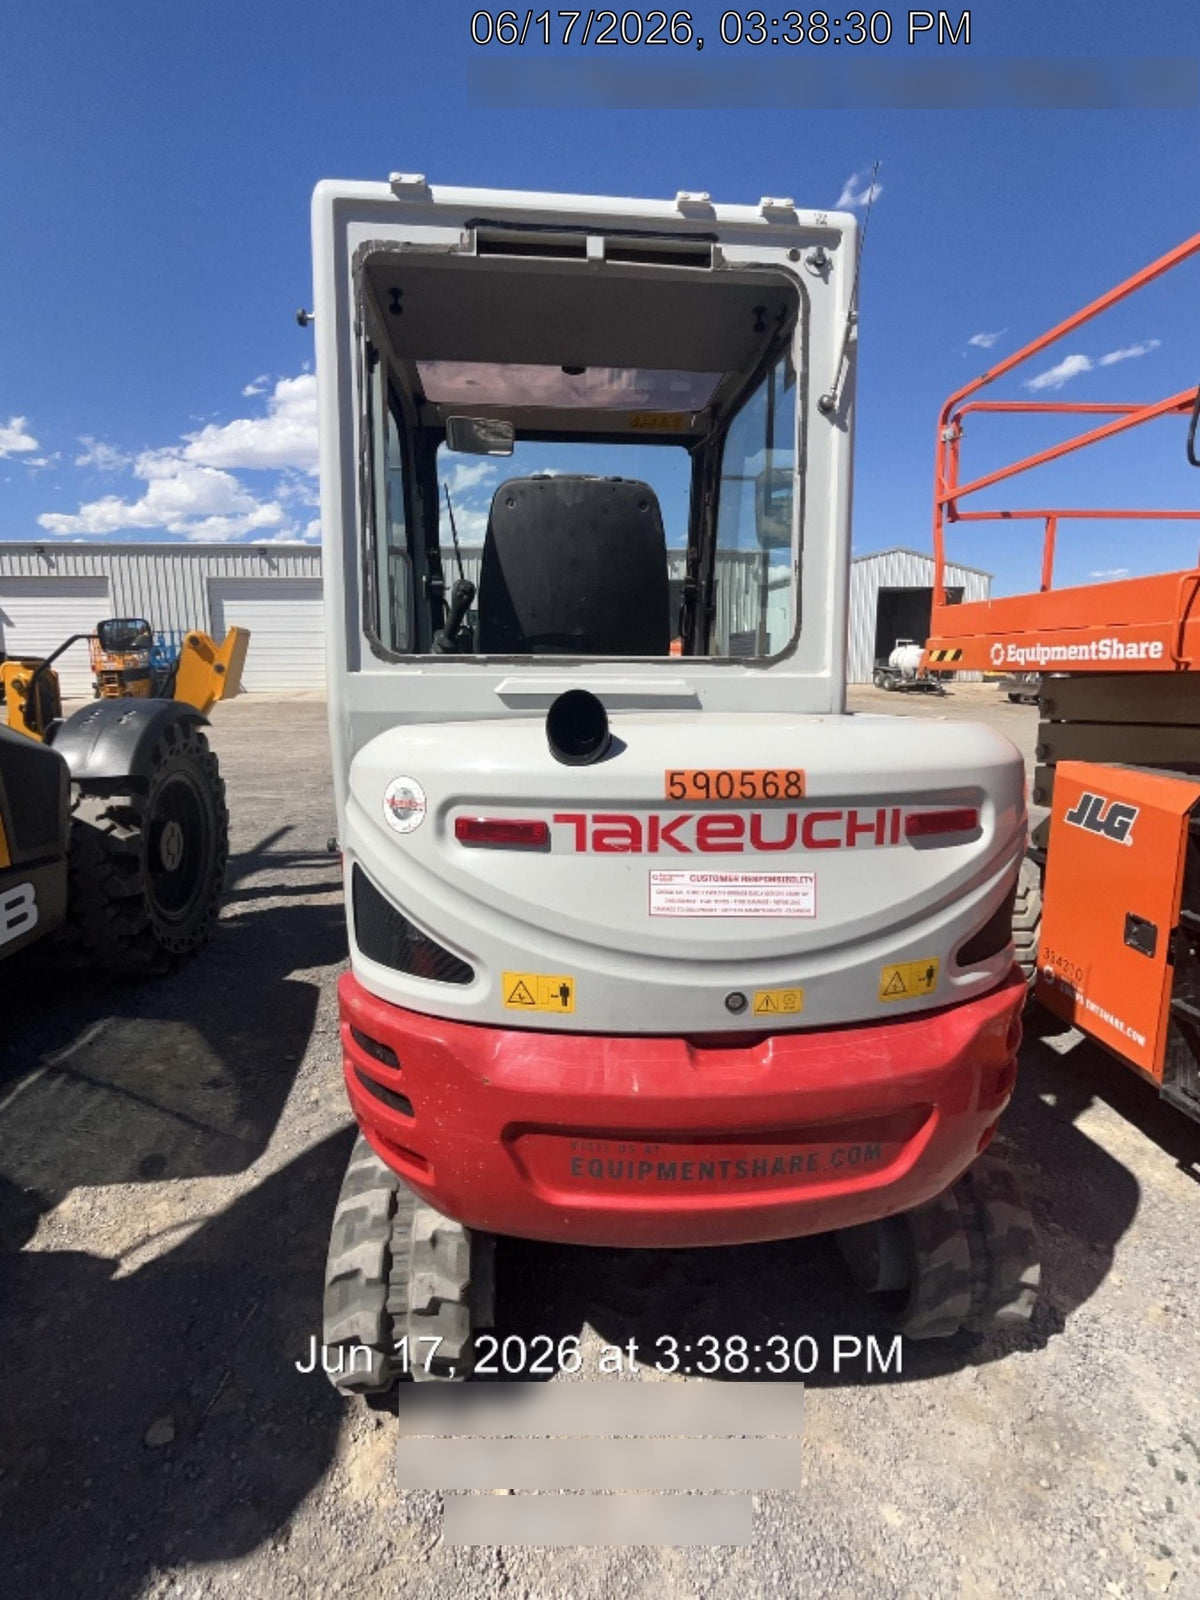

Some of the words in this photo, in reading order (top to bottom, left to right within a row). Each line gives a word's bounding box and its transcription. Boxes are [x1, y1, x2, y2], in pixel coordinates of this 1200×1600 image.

[1006, 638, 1163, 665] EquipmentShare
[668, 770, 803, 800] 590568
[1063, 791, 1140, 846] JLG
[570, 1140, 882, 1181] EQUIPMENTSHARE.COM
